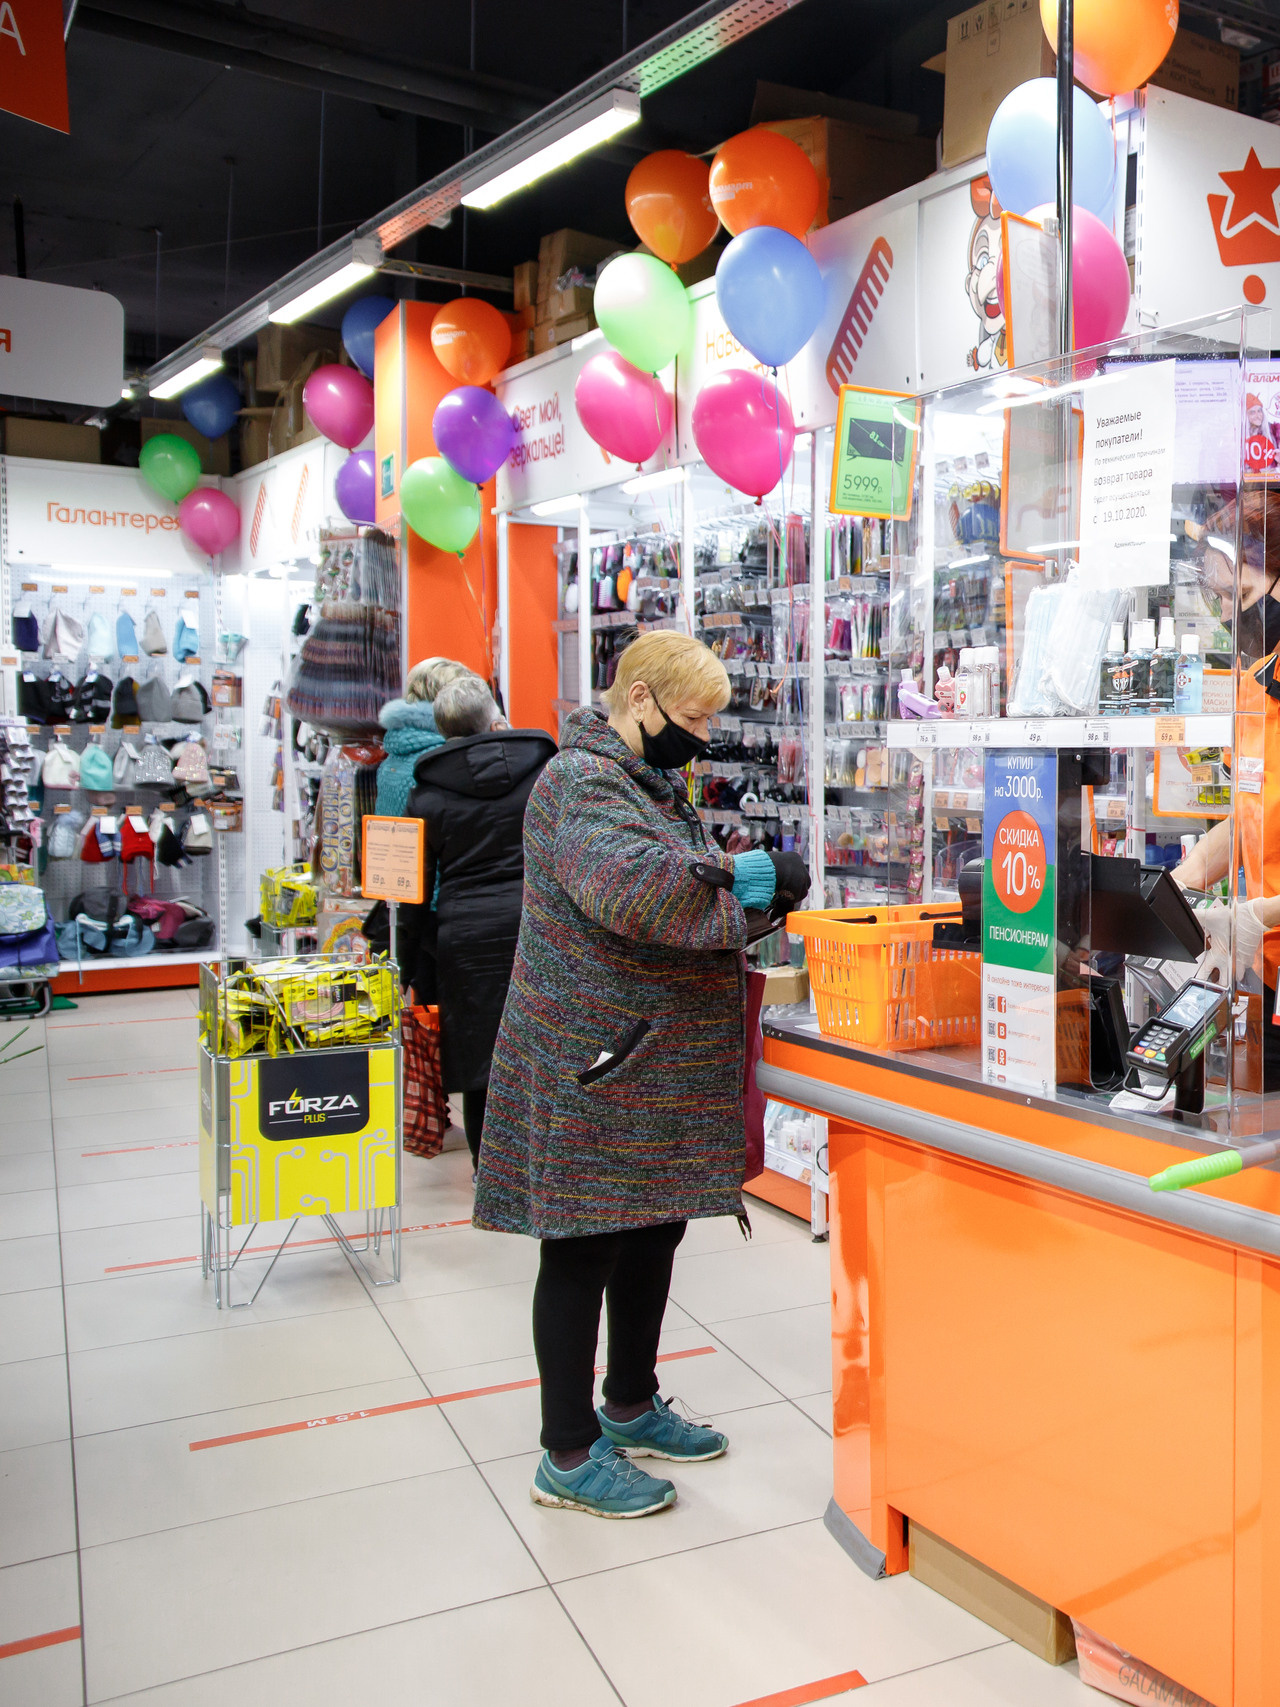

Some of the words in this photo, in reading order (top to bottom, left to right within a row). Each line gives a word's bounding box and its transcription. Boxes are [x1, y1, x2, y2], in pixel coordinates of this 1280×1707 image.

[513, 405, 536, 432] Свет
[539, 392, 561, 424] мой,
[1096, 410, 1142, 429] Уважаемые
[510, 424, 565, 472] зеркальце!
[1095, 429, 1143, 449] покупатели!
[1093, 471, 1124, 487] возврат
[1125, 467, 1153, 482] товара
[1007, 756, 1034, 770] КУПИЛ
[994, 787, 1004, 798] на
[1004, 775, 1043, 801] 3000р.
[999, 827, 1040, 848] СКИДКА
[397, 877, 405, 887] 69
[1002, 851, 1041, 897] 10%
[989, 925, 1049, 948] ПЕНСИОНЕРАМ
[1011, 979, 1022, 988] тоже
[1023, 981, 1050, 993] интересно!
[269, 1092, 358, 1117] FORZA
[304, 1113, 326, 1123] PLUS
